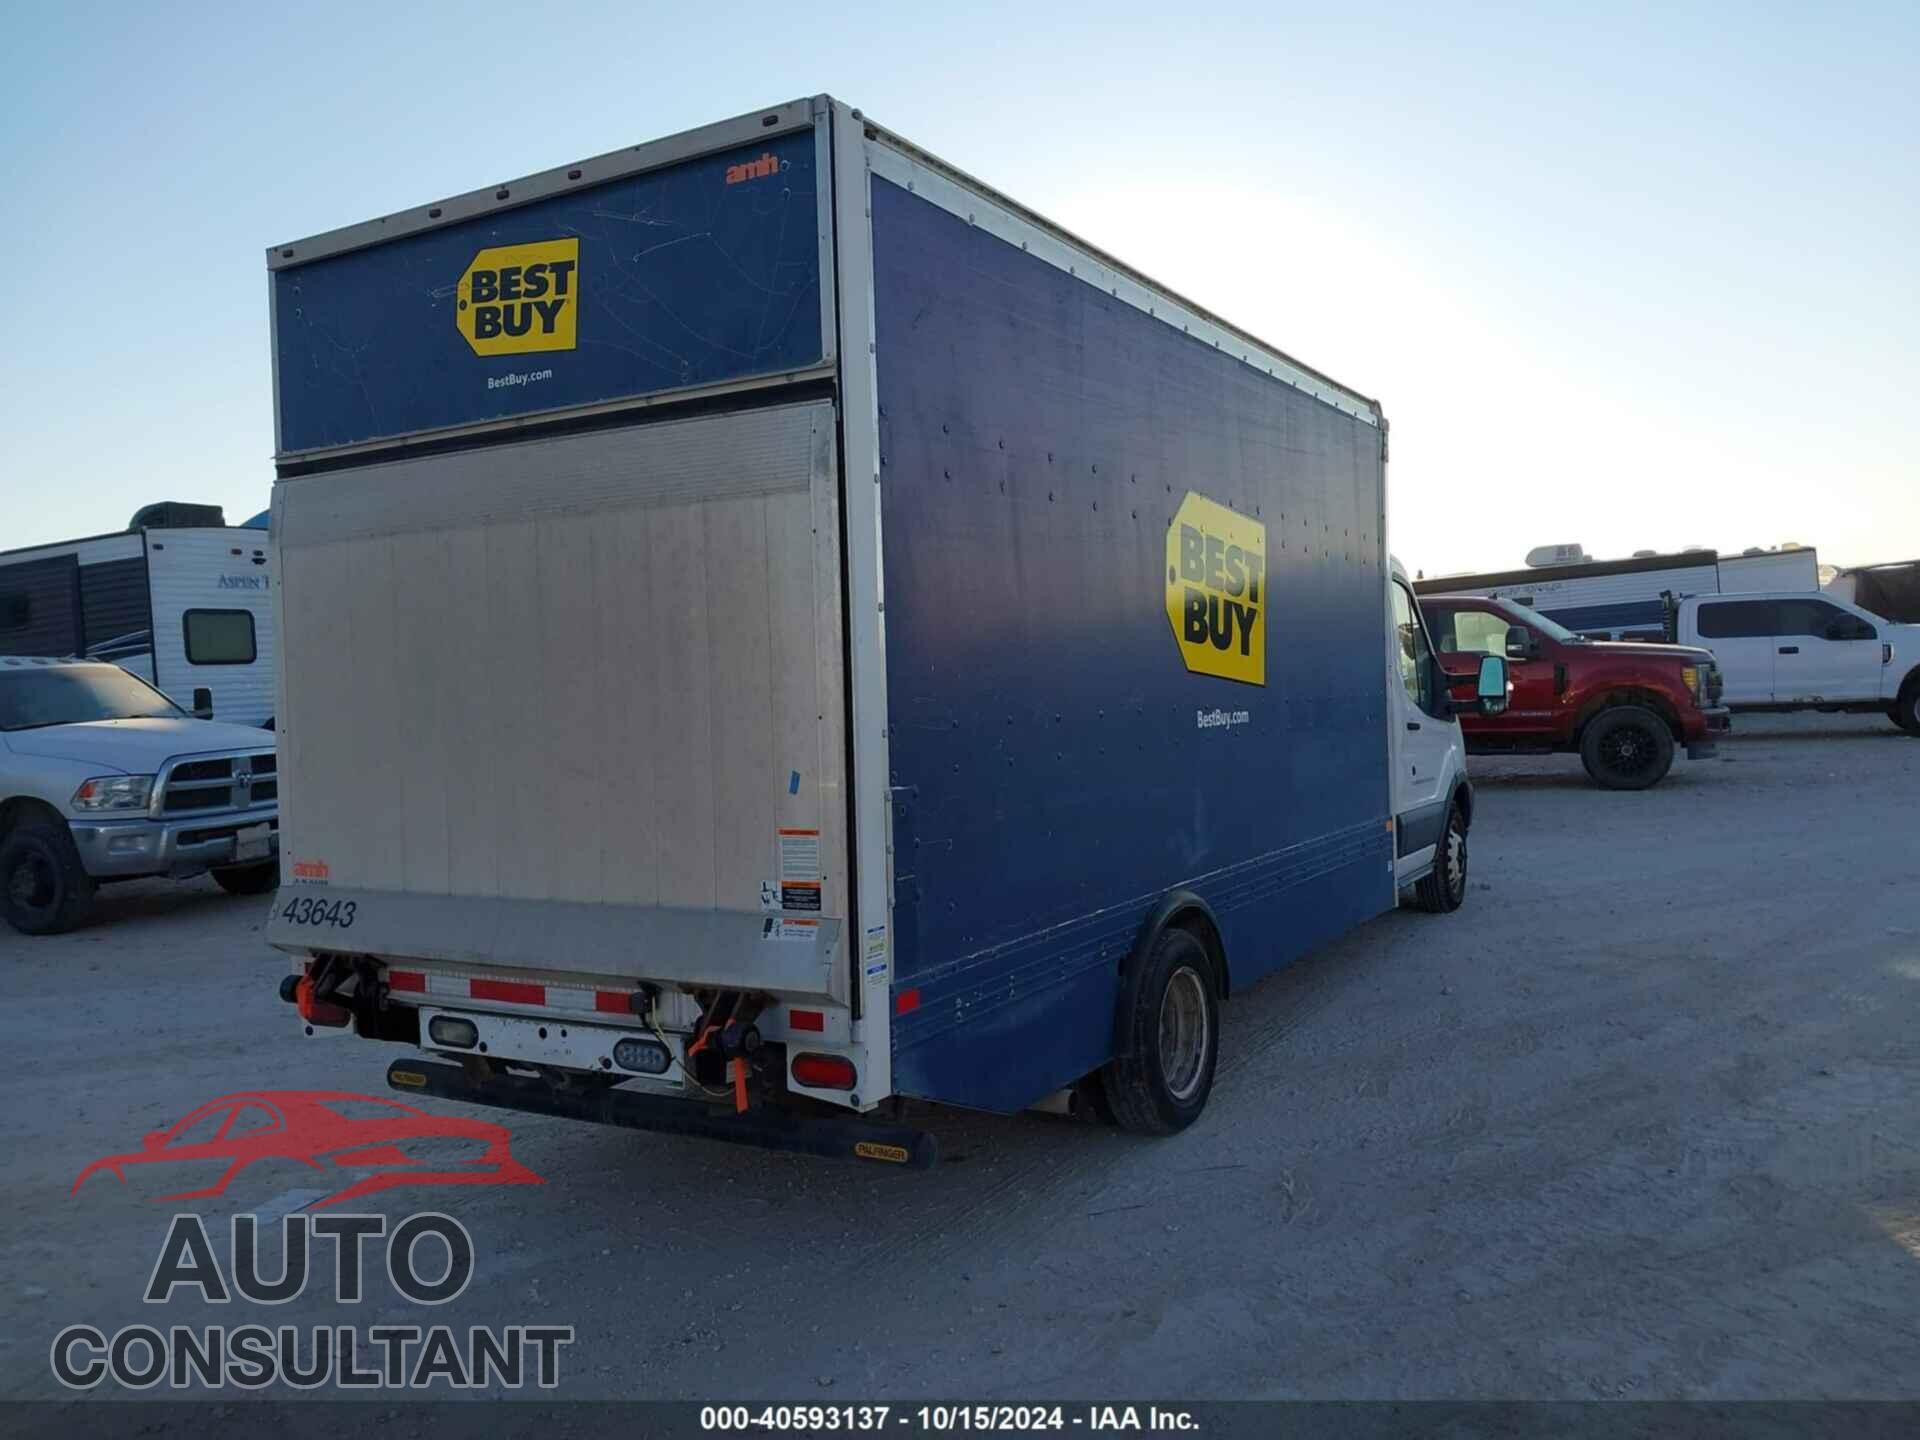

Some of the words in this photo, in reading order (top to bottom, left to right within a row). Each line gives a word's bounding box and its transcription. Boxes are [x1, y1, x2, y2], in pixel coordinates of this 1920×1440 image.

[726, 152, 778, 184] amh
[471, 260, 575, 304] BEST
[475, 299, 566, 339] BUY
[487, 369, 552, 389] BestBuy.com
[1180, 523, 1264, 603] BEST
[1184, 586, 1257, 656] BUY
[1197, 709, 1249, 730] BestBuy.com
[282, 897, 356, 928] 43643
